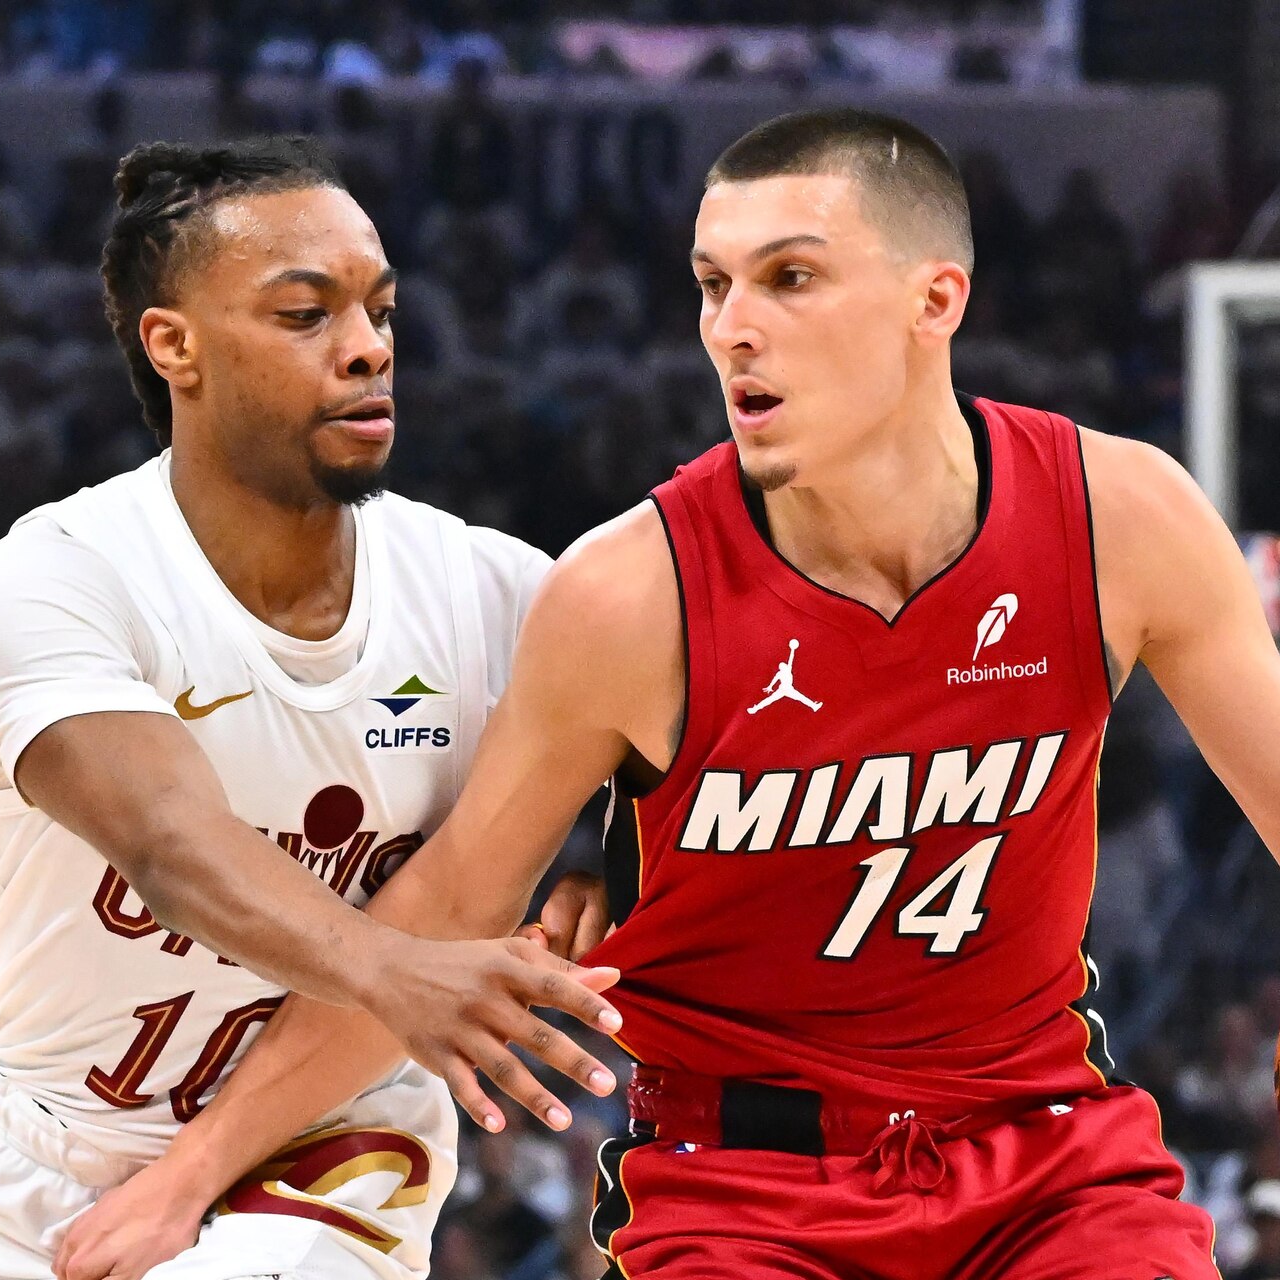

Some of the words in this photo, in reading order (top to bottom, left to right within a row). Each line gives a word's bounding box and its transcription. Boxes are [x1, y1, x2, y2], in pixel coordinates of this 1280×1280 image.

[946, 657, 1048, 685] Robinhood
[364, 726, 451, 750] CLIFFS
[676, 730, 1068, 853] MIAMI
[818, 832, 1008, 962] 14
